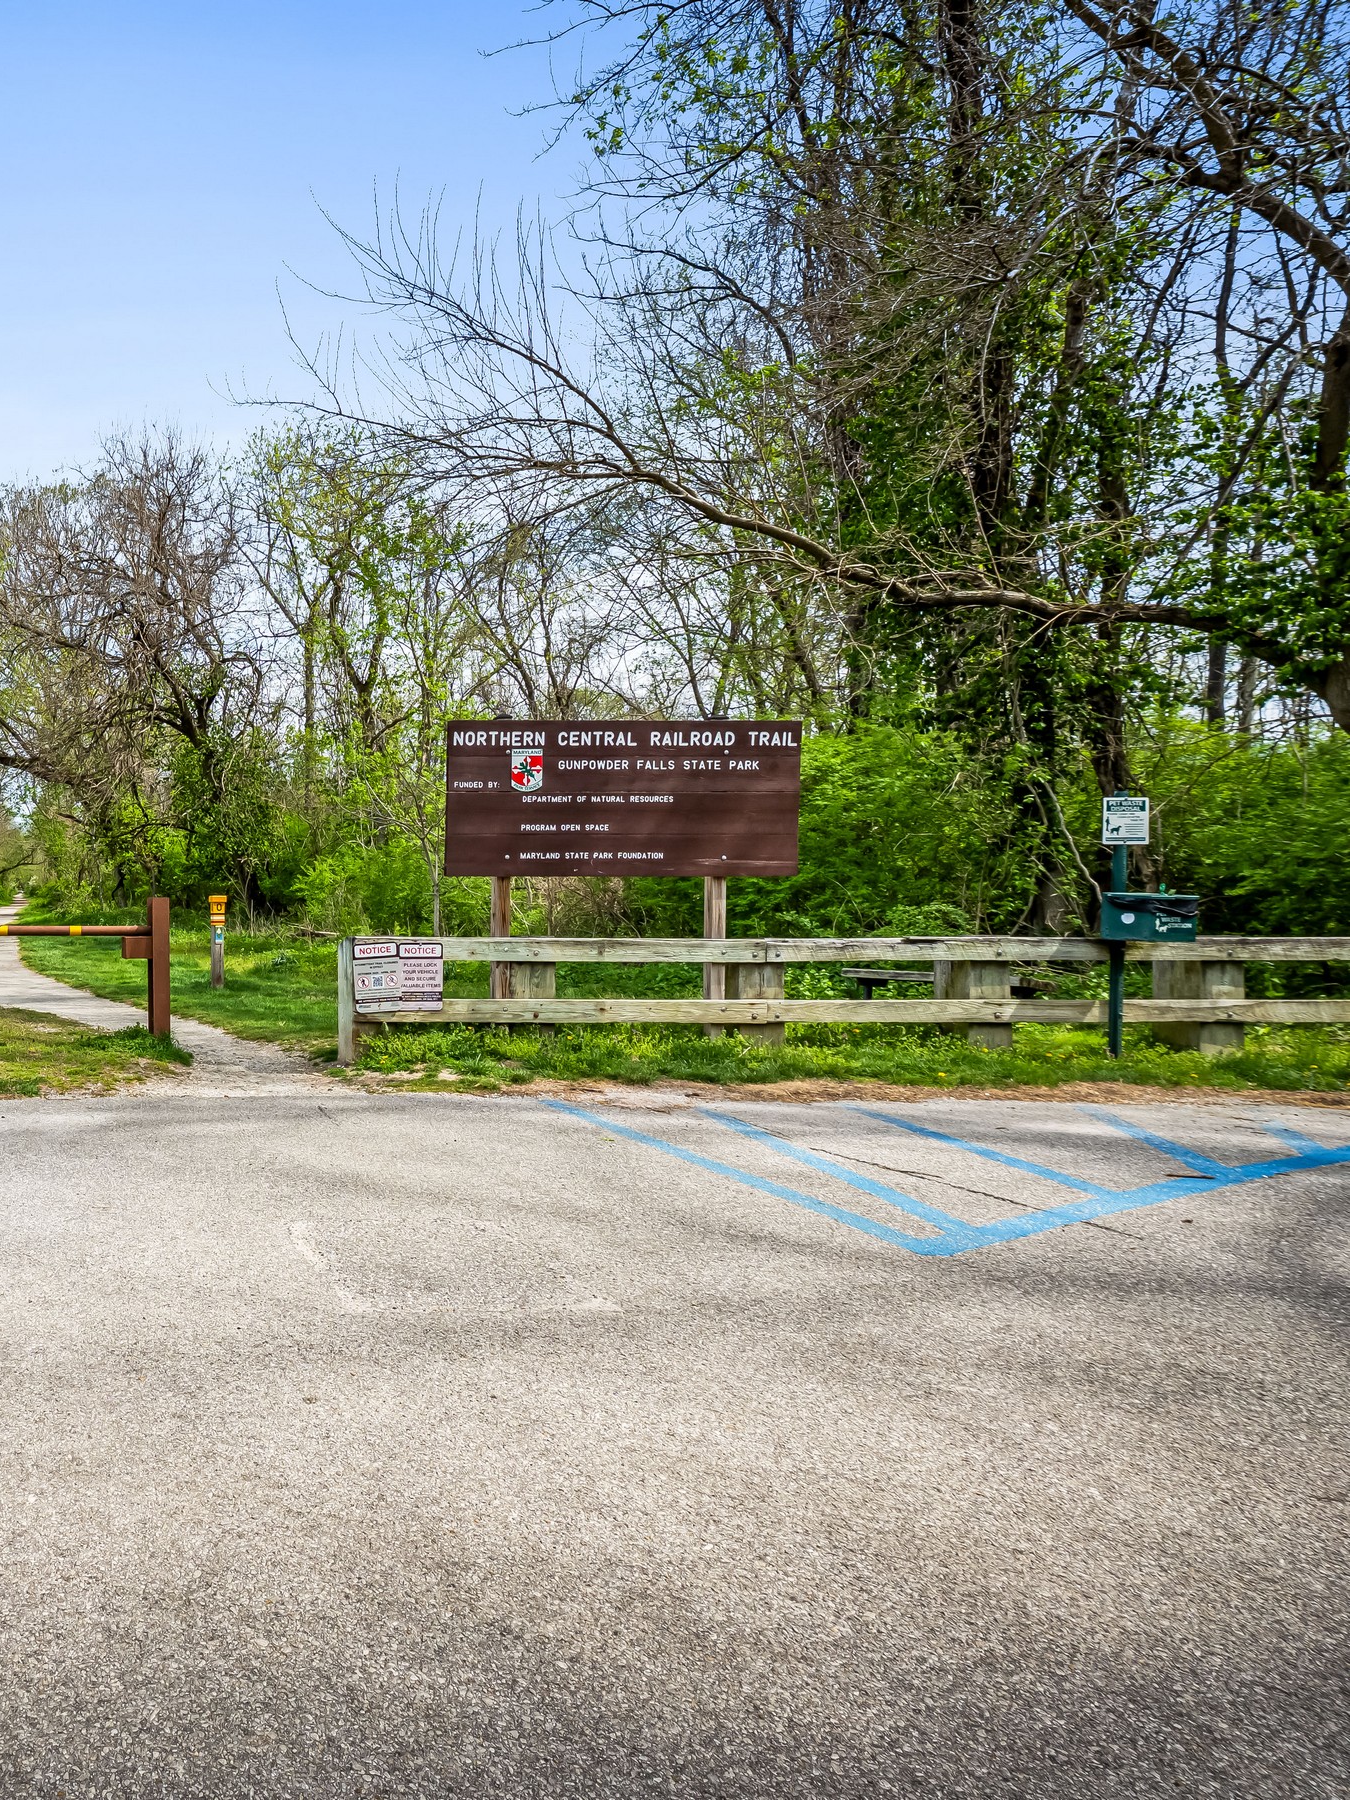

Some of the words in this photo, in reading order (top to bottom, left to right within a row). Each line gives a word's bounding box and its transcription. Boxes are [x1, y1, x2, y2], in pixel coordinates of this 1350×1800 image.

[453, 731, 546, 747] NORTHERN
[558, 731, 637, 747] CENTRAL
[650, 731, 736, 747] RAILROAD
[749, 731, 798, 747] TRAIL
[558, 760, 629, 770] GUNPOWDER
[637, 760, 675, 770] FALLS
[683, 760, 721, 770] STATE
[729, 761, 760, 770] PARK
[359, 946, 391, 955] NOTICE
